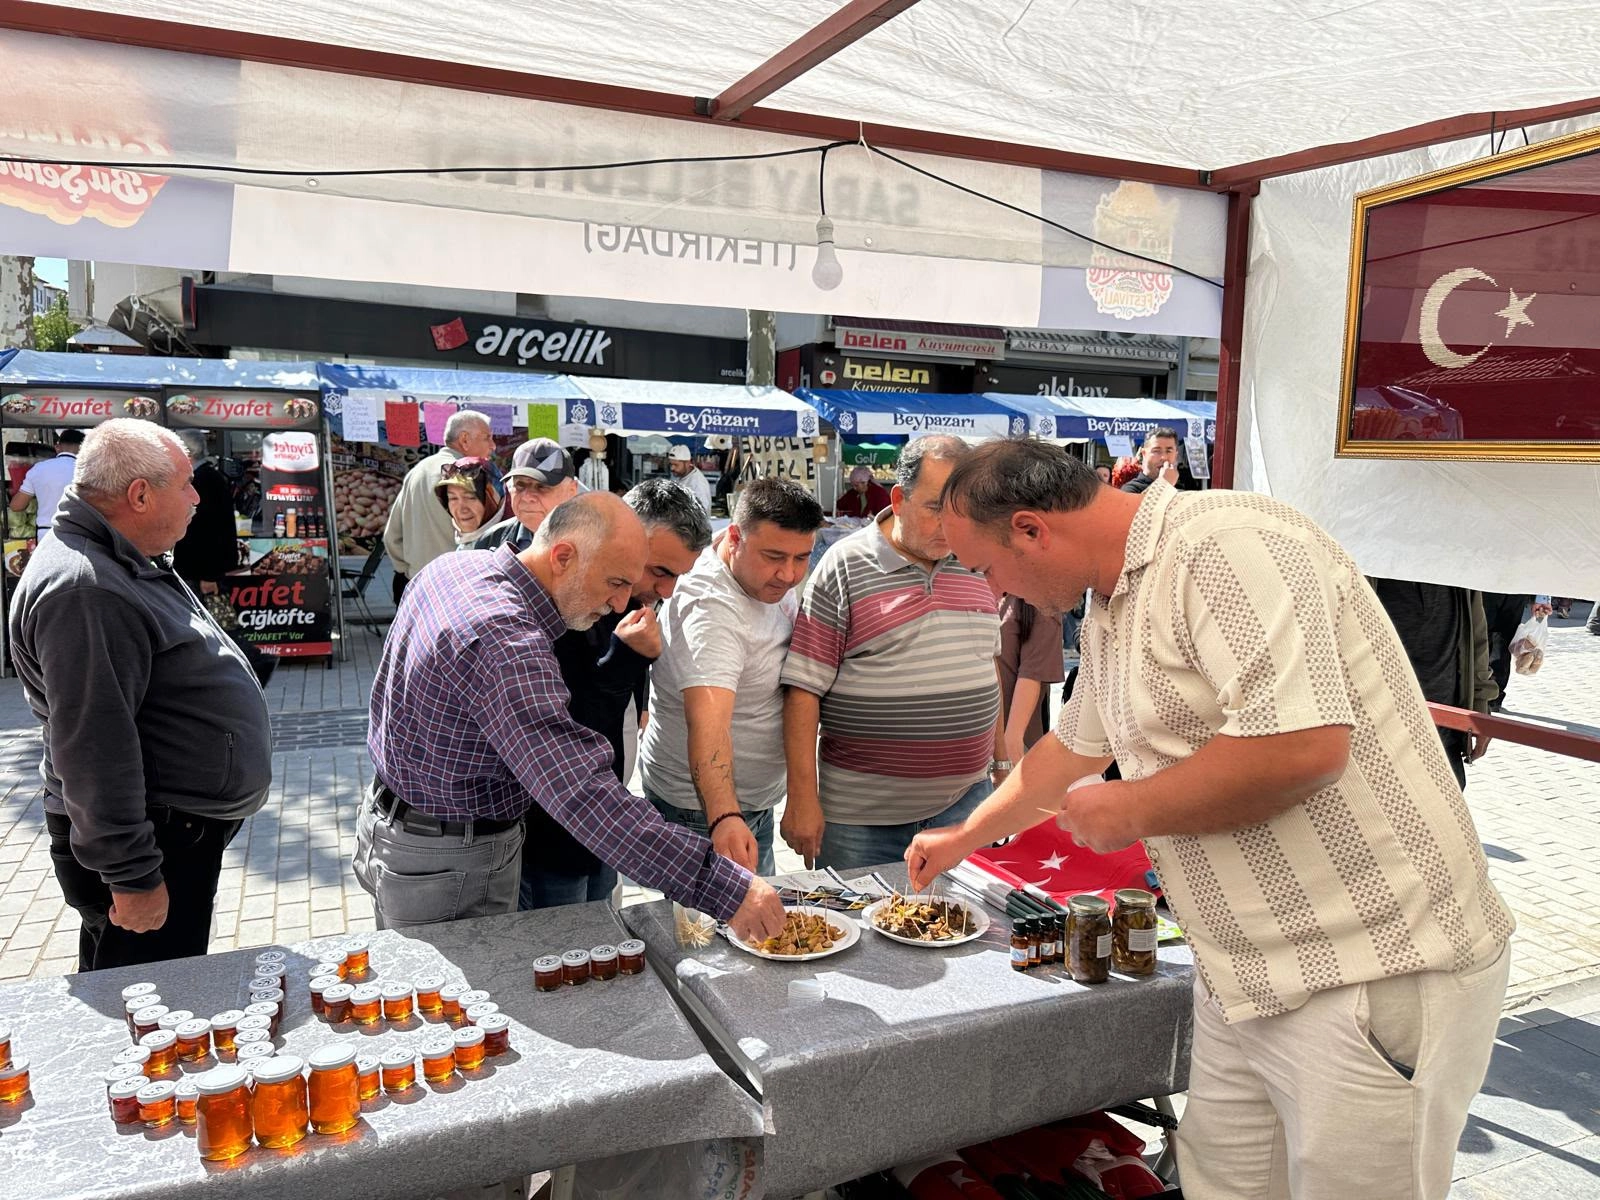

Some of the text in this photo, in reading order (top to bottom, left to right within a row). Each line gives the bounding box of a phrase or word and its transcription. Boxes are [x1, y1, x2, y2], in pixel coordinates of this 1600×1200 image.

[475, 324, 612, 365] arçelik
[844, 331, 907, 350] belen
[843, 357, 930, 384] belen
[1037, 376, 1109, 398] akbay
[39, 396, 113, 420] Ziyafet
[203, 397, 273, 421] Ziyafet
[664, 407, 760, 431] Beypazarı
[893, 412, 975, 431] Beypazarı
[1087, 417, 1159, 435] Beypazarı
[855, 452, 878, 464] Golf
[238, 608, 316, 630] Çiğköfte
